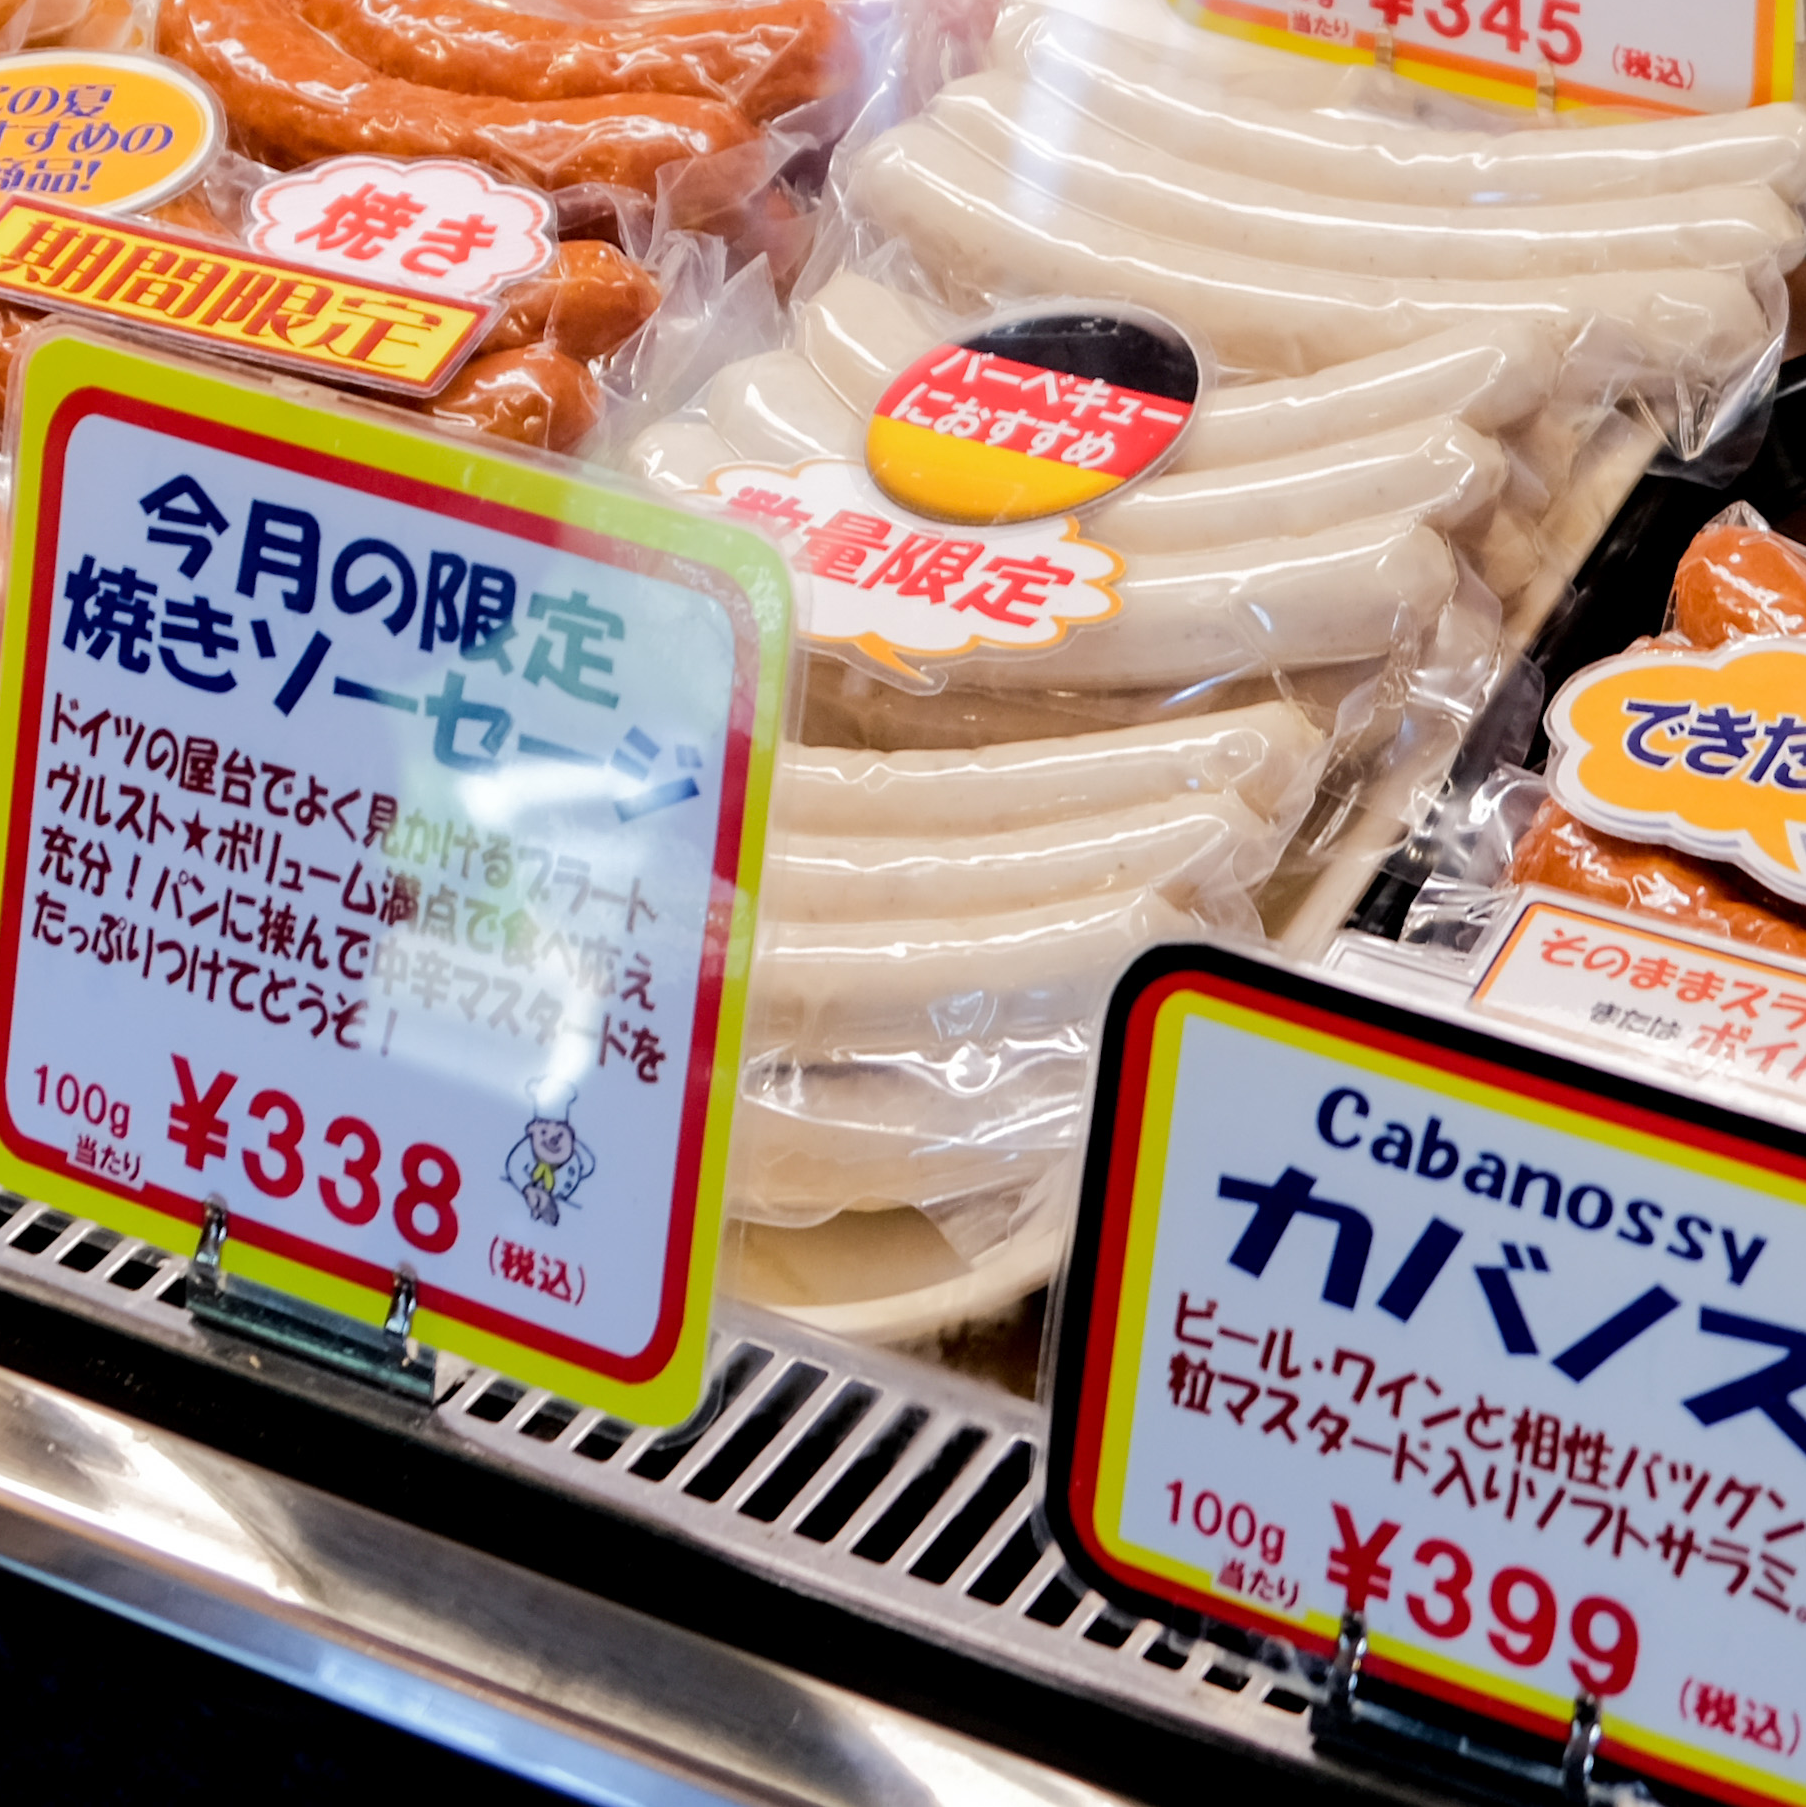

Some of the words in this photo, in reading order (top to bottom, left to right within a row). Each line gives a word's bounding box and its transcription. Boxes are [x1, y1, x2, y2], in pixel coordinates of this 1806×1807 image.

[1292, 12, 1356, 42] 当たり
[1611, 44, 1695, 90] (税込)
[295, 182, 496, 279] 焼き
[889, 383, 1118, 470] におすすめ
[929, 346, 1184, 428] バーベキュー
[139, 471, 629, 709] 今月の限定
[63, 553, 702, 827] 焼きソーセージ
[1591, 999, 1682, 1042] または
[32, 1063, 132, 1139] 100g
[166, 1050, 464, 1257] ¥338
[486, 1237, 589, 1308] (税込)
[72, 1134, 144, 1183] 当たり
[1314, 1084, 1769, 1286] Cabanossy
[1162, 1479, 1289, 1564] 100g
[1326, 1500, 1640, 1700] ¥399
[1678, 1677, 1804, 1756] (税込)
[1214, 1556, 1303, 1611] 当たり
